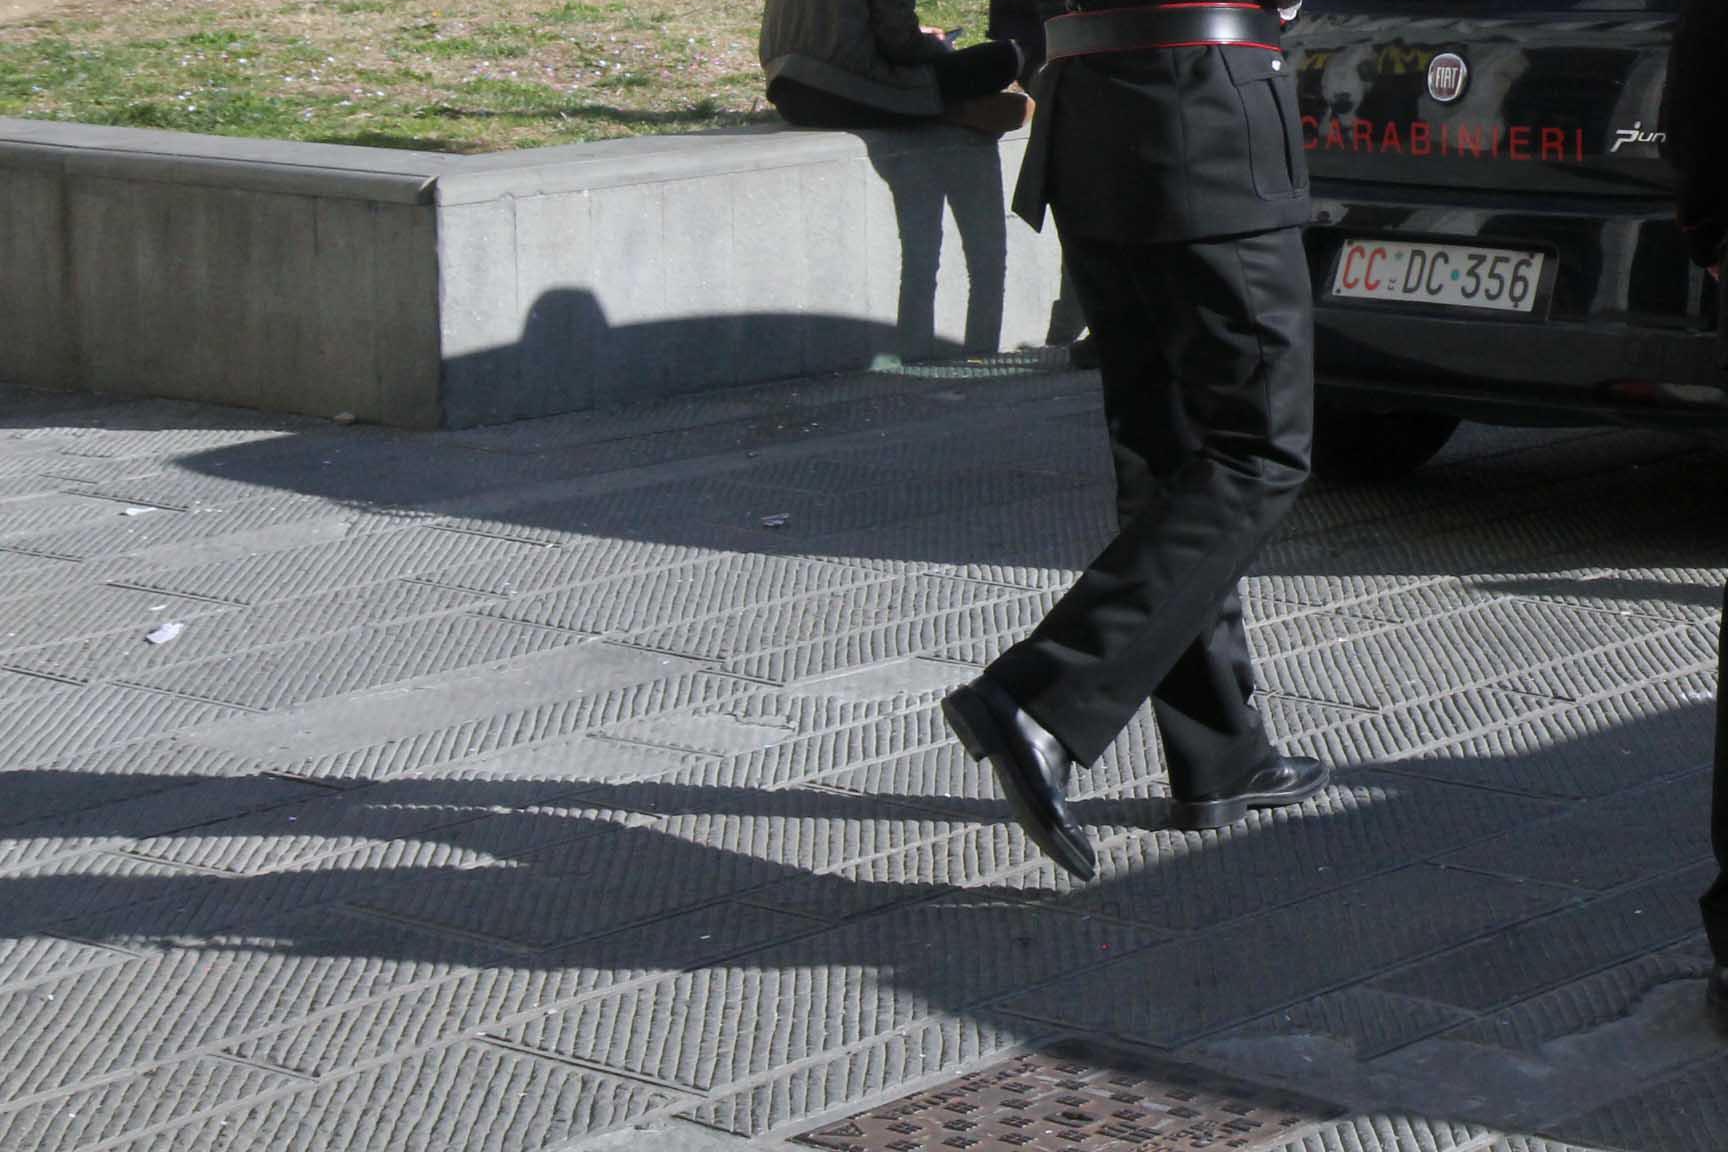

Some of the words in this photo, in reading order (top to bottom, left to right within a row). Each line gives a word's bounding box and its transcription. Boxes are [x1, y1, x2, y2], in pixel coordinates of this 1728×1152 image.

[1435, 66, 1459, 89] FIAT
[1300, 114, 1585, 162] CARABINIERI
[1609, 120, 1667, 153] Pun
[1341, 245, 1388, 291] CC
[1402, 249, 1450, 296] DC
[1461, 253, 1533, 305] 356
